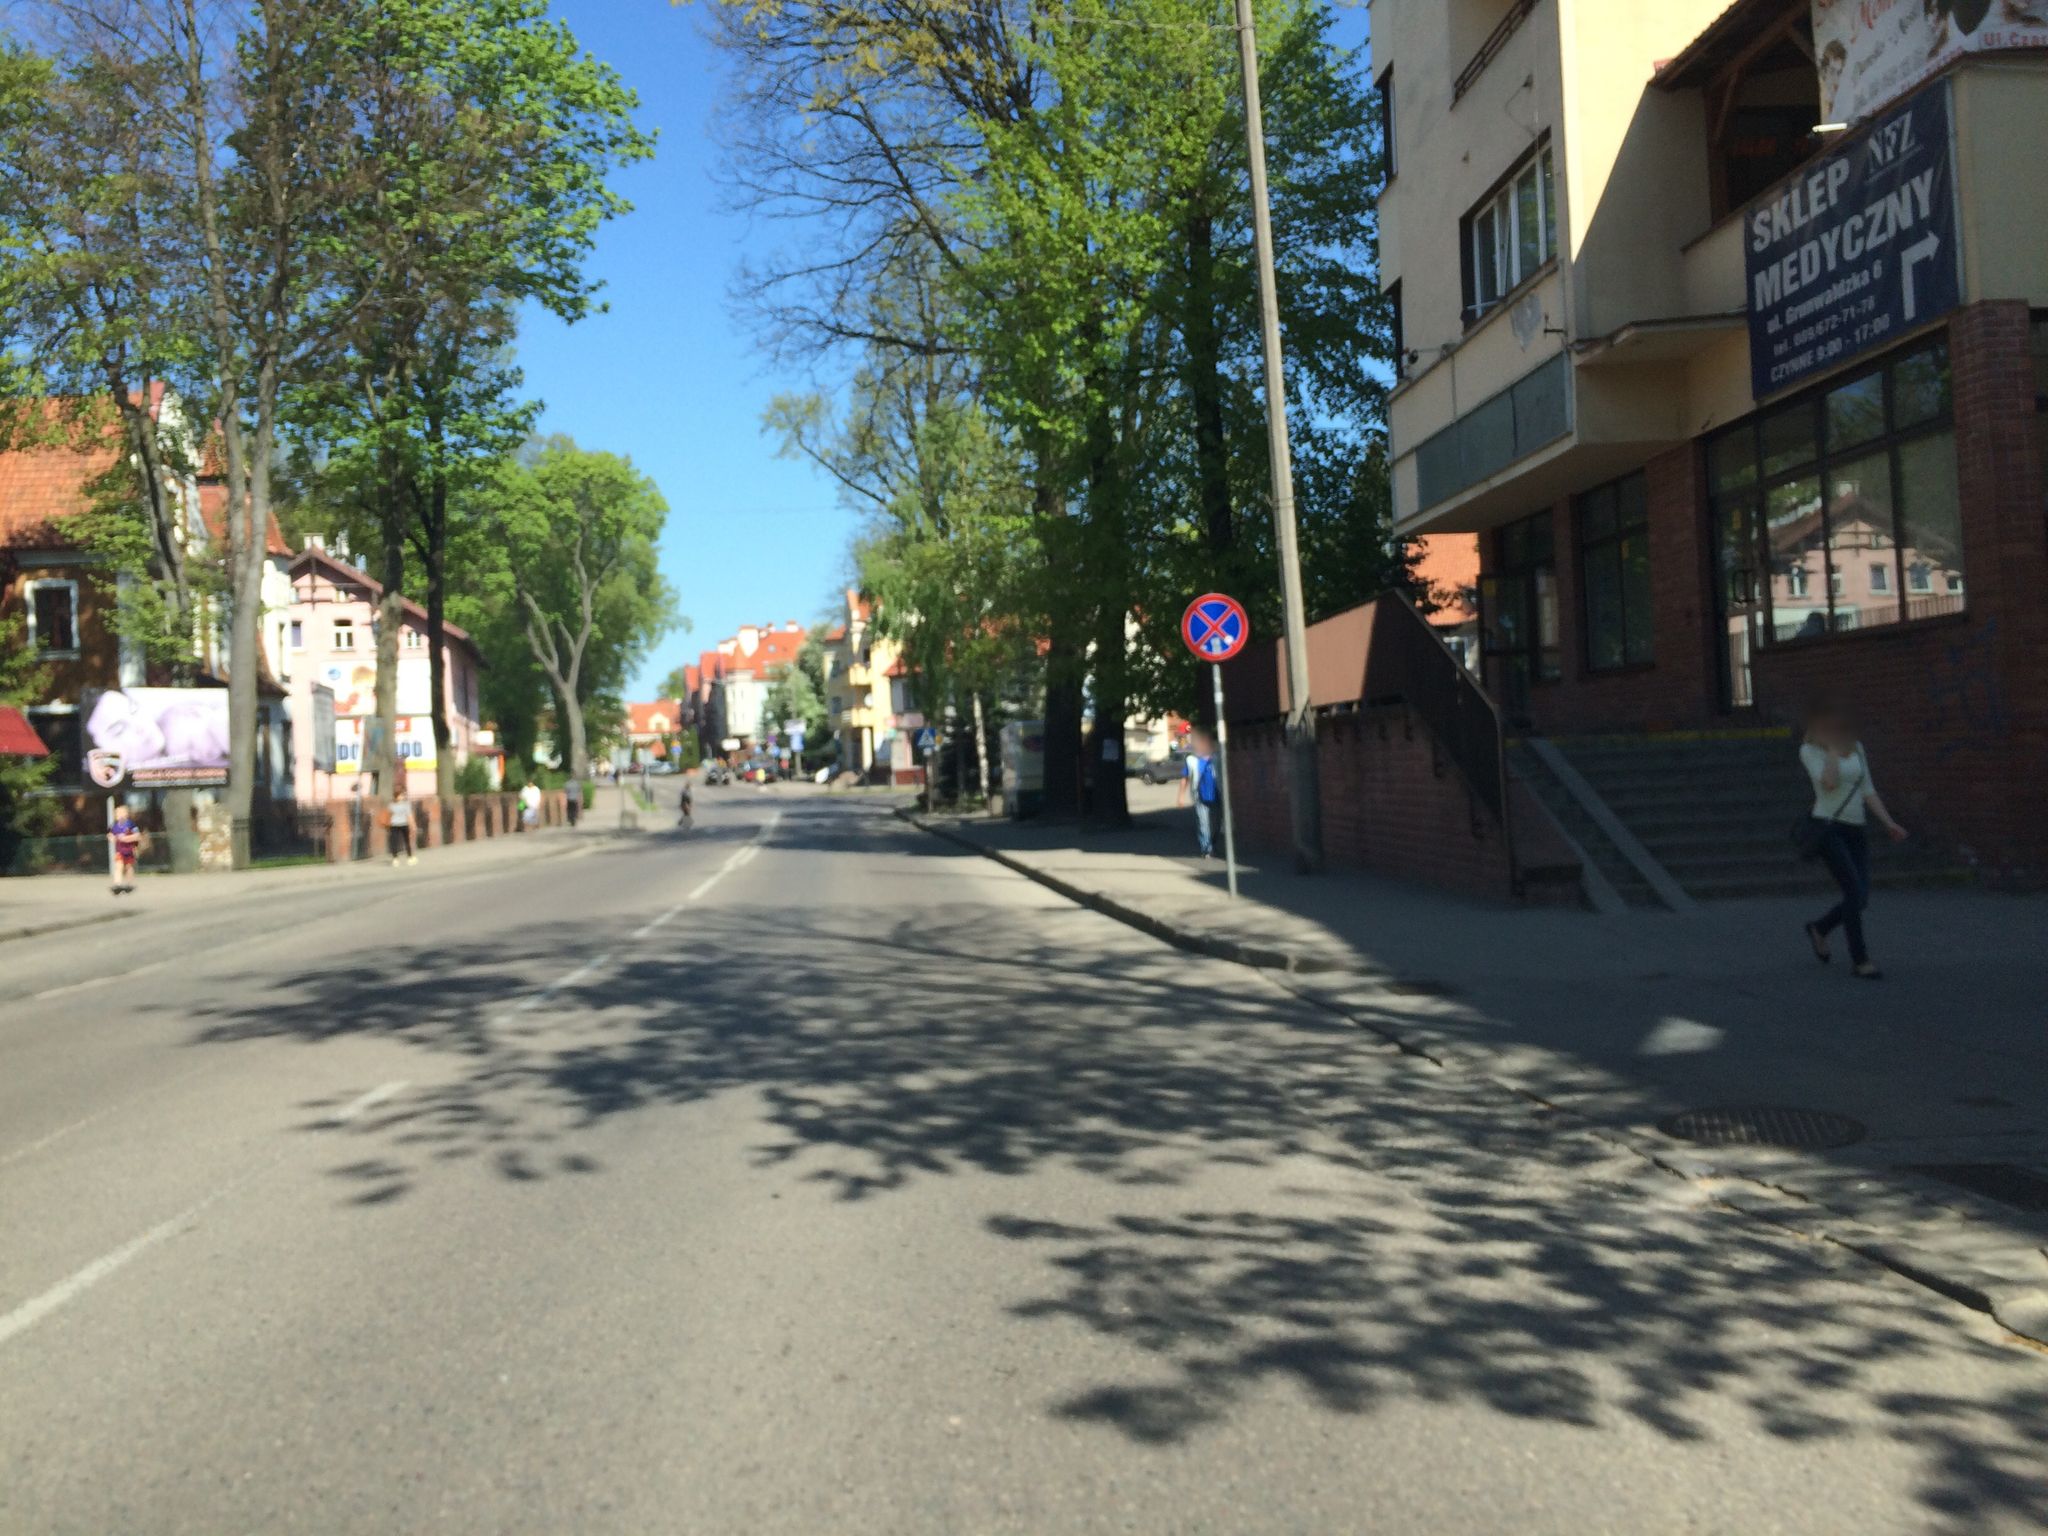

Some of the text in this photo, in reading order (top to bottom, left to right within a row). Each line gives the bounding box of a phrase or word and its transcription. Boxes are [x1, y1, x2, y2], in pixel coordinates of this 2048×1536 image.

[1752, 158, 1850, 252] SKLEP
[1754, 167, 1935, 312] MEDYCZNY
[1766, 313, 1783, 335] ul.
[1769, 350, 1814, 383] CZYNNE
